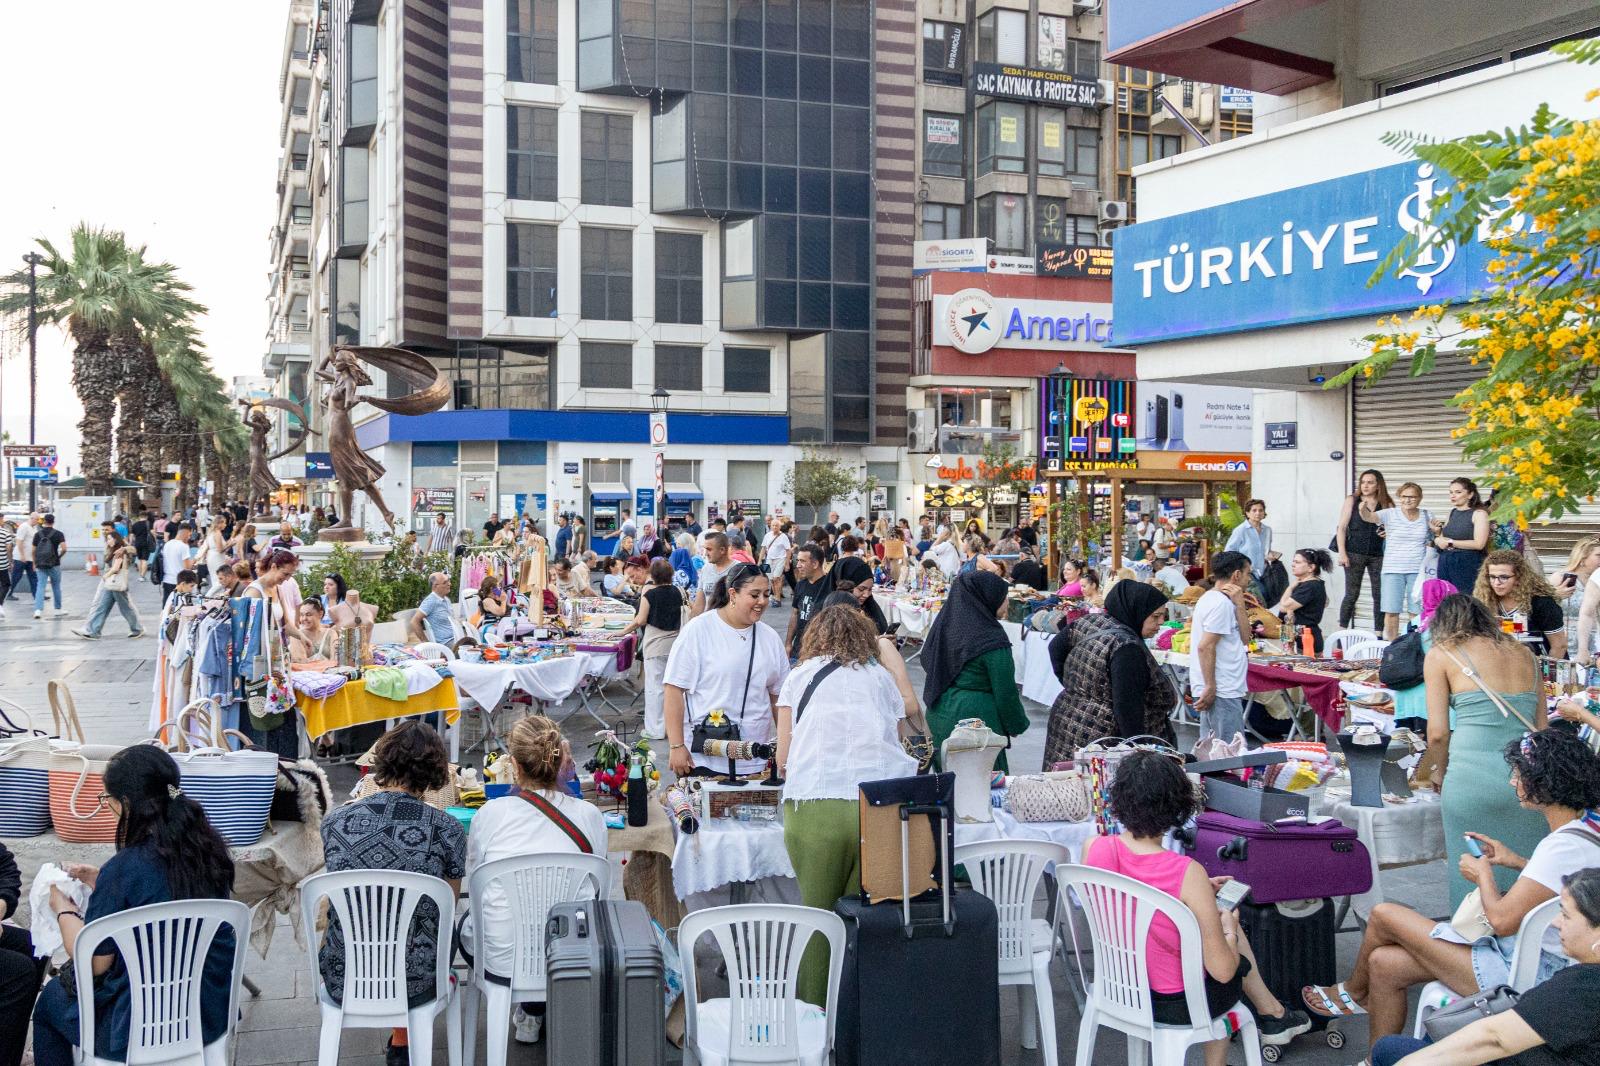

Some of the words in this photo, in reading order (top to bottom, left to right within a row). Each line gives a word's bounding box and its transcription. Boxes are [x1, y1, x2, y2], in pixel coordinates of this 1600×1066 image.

[1003, 66, 1026, 76] SEDAT
[1027, 70, 1045, 79] HAIR
[1044, 72, 1073, 82] CENTER
[977, 73, 996, 94] SAÇ
[996, 75, 1033, 97] KAYNAK
[1034, 79, 1042, 98] &
[1043, 81, 1077, 103] PROTEZ
[1078, 85, 1096, 105] SAÇ
[1133, 215, 1379, 298] TÜRKİYE
[1206, 402, 1226, 411] Redmi
[1226, 403, 1242, 411] Note
[1271, 430, 1288, 439] YALI
[1184, 461, 1247, 472] TEKNOSA
[1286, 808, 1305, 816] ecco
